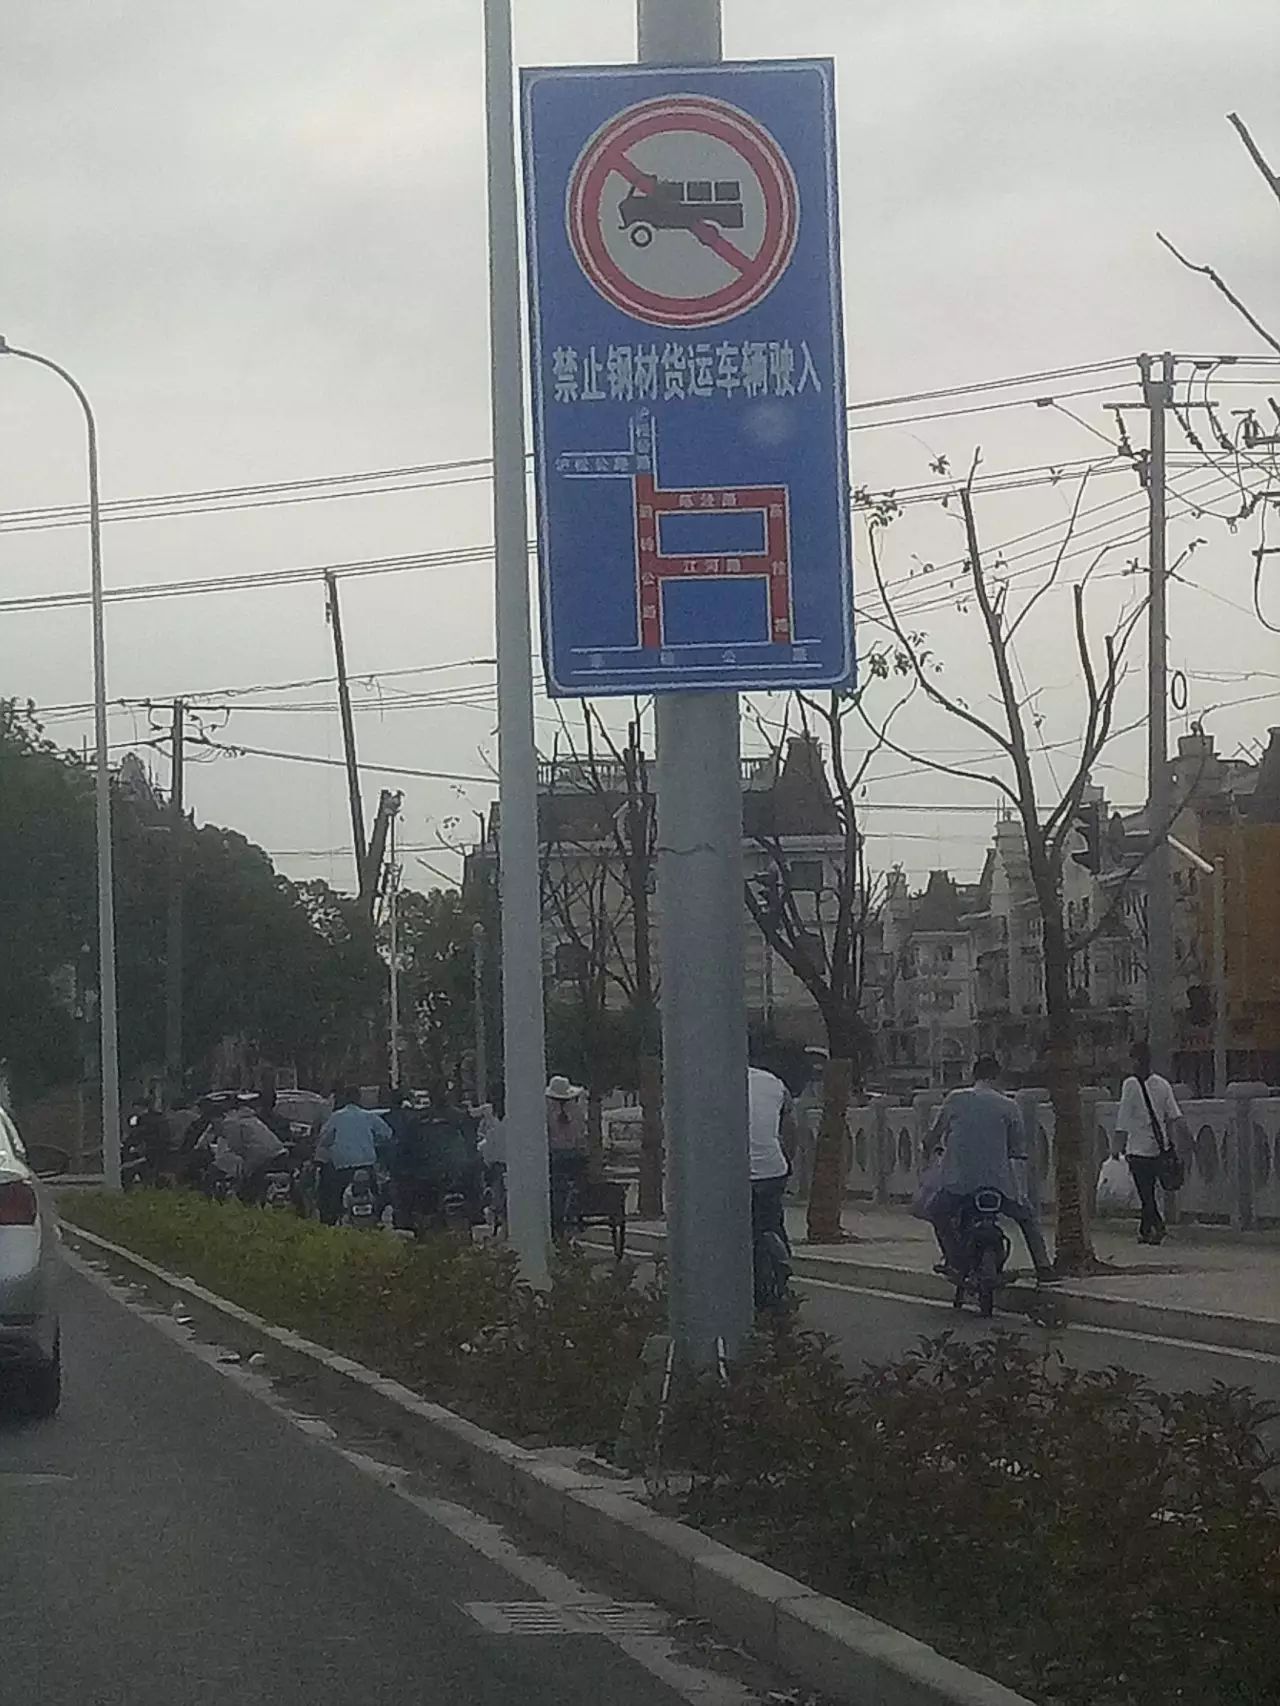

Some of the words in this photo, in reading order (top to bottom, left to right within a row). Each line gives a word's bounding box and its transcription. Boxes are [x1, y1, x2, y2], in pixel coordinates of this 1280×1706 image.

[553, 341, 821, 402] 禁止钢材货运车辆驶入
